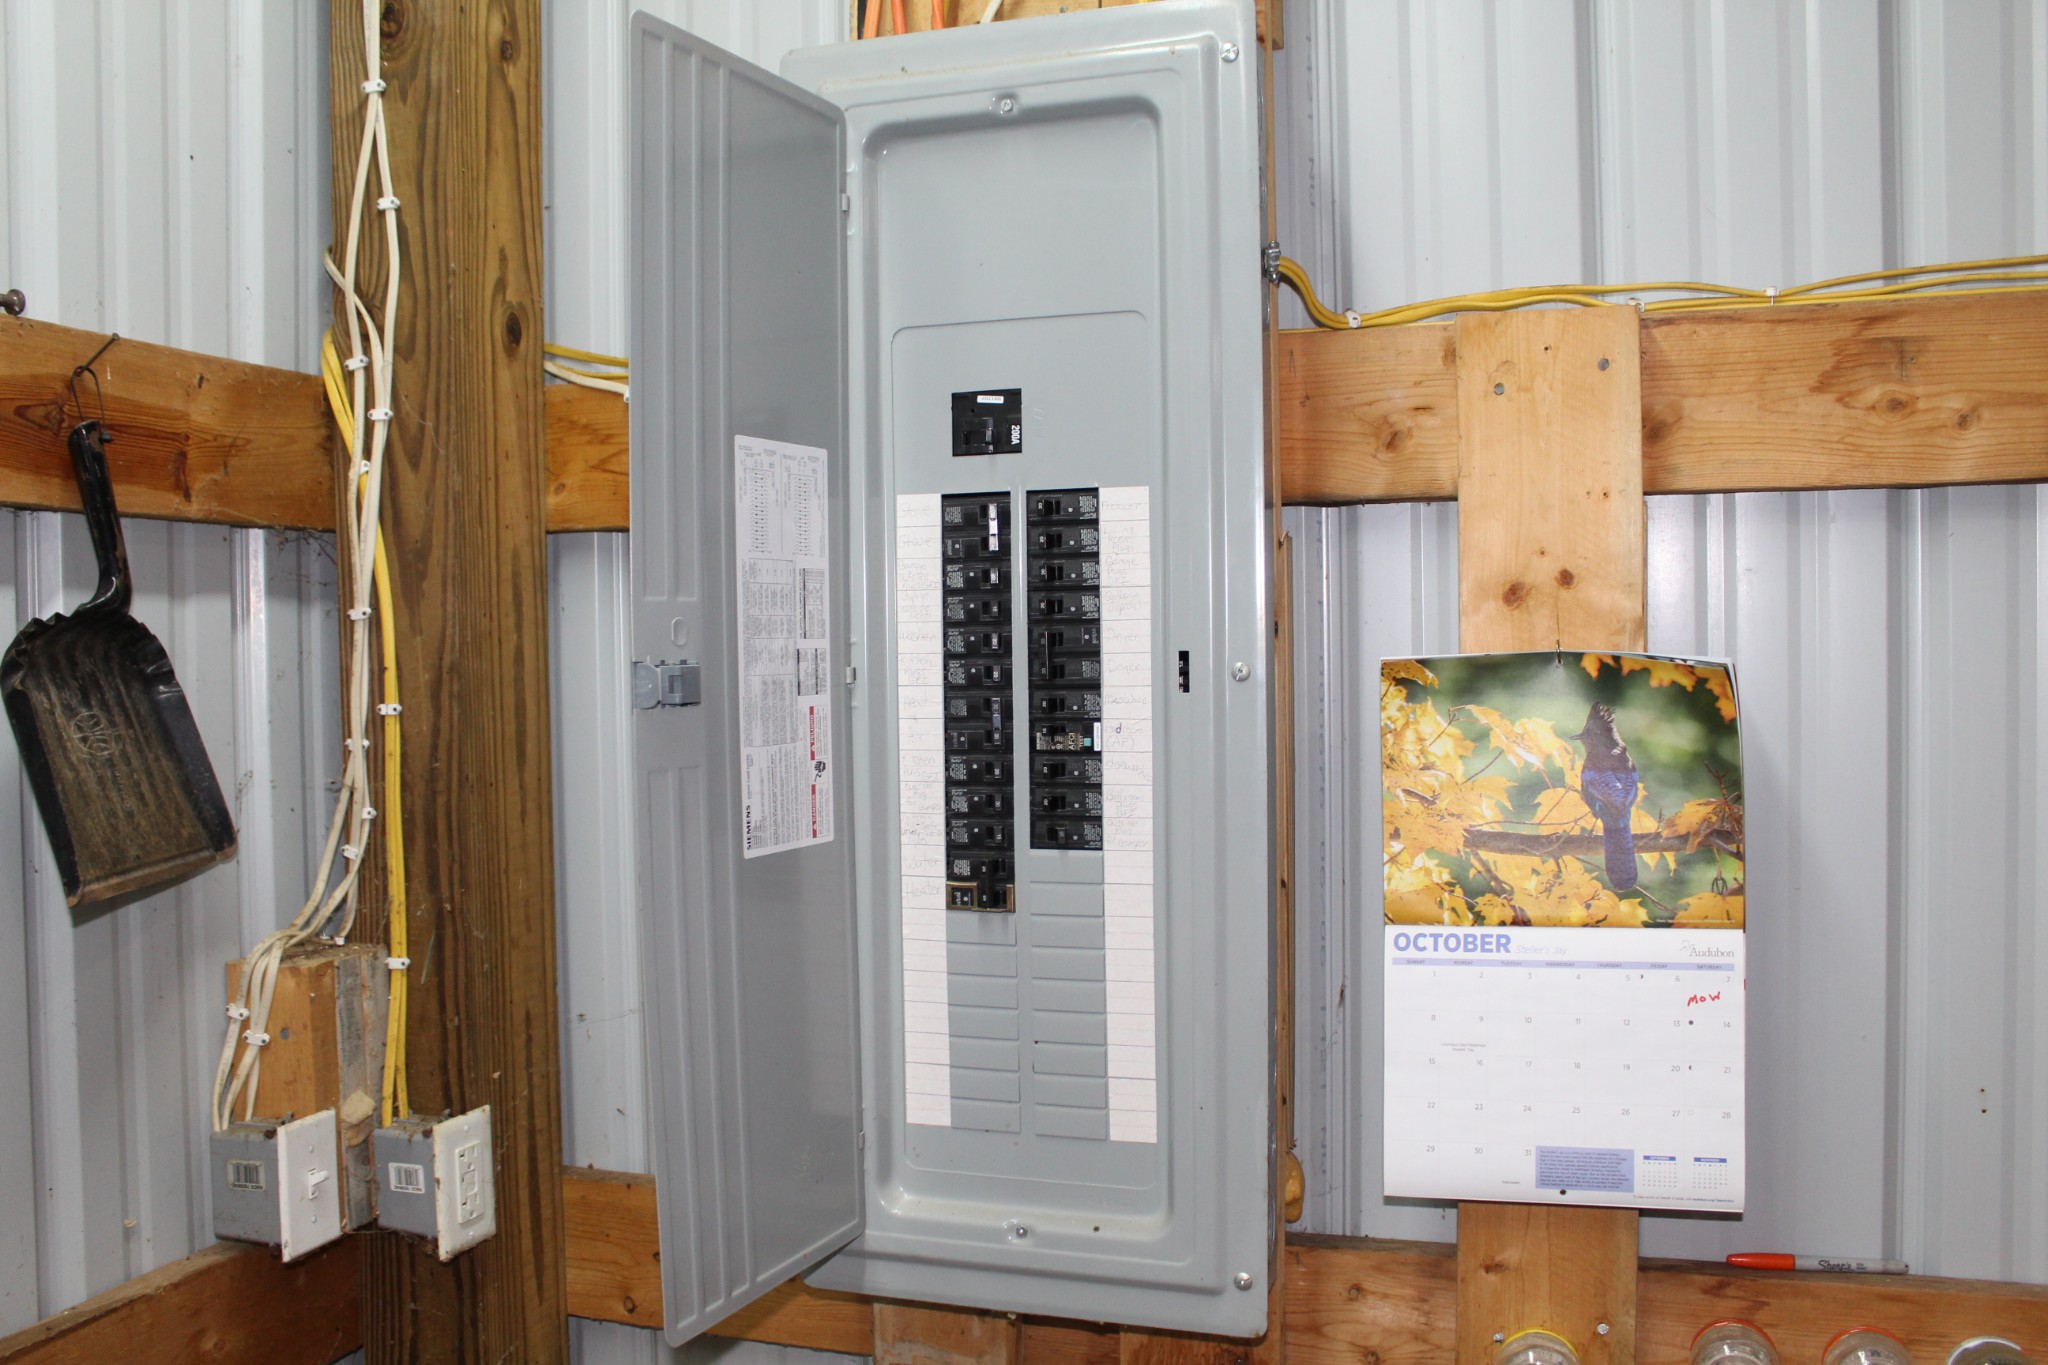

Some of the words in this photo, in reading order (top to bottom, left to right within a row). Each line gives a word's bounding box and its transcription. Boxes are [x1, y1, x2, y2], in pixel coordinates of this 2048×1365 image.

[1011, 425, 1021, 445] 200A
[1393, 932, 1512, 954] OCTOBER
[1553, 946, 1567, 956] Jay
[1689, 947, 1735, 958] Audubon
[1524, 1016, 1533, 1024] 10
[1575, 1017, 1581, 1025] 11
[1623, 1019, 1631, 1027] 12
[1672, 1019, 1681, 1028] 13
[1722, 1021, 1731, 1029] 14
[1428, 1057, 1436, 1065] 15
[1476, 1059, 1484, 1067] 16
[1525, 1060, 1532, 1068] 17
[1573, 1062, 1581, 1070] 18
[1623, 1063, 1631, 1071] 19
[1670, 1064, 1681, 1073] 20
[1723, 1066, 1731, 1074] 21
[1427, 1101, 1436, 1109] 22
[1474, 1103, 1484, 1111] 23
[1523, 1105, 1532, 1113] 24
[1571, 1106, 1581, 1114] 25
[1621, 1108, 1631, 1116] 26
[1721, 1111, 1732, 1120] 28
[1426, 1145, 1436, 1153] 29
[1474, 1147, 1484, 1155] 30
[1524, 1149, 1532, 1157] 31
[1818, 1259, 1854, 1272] Sharpie
